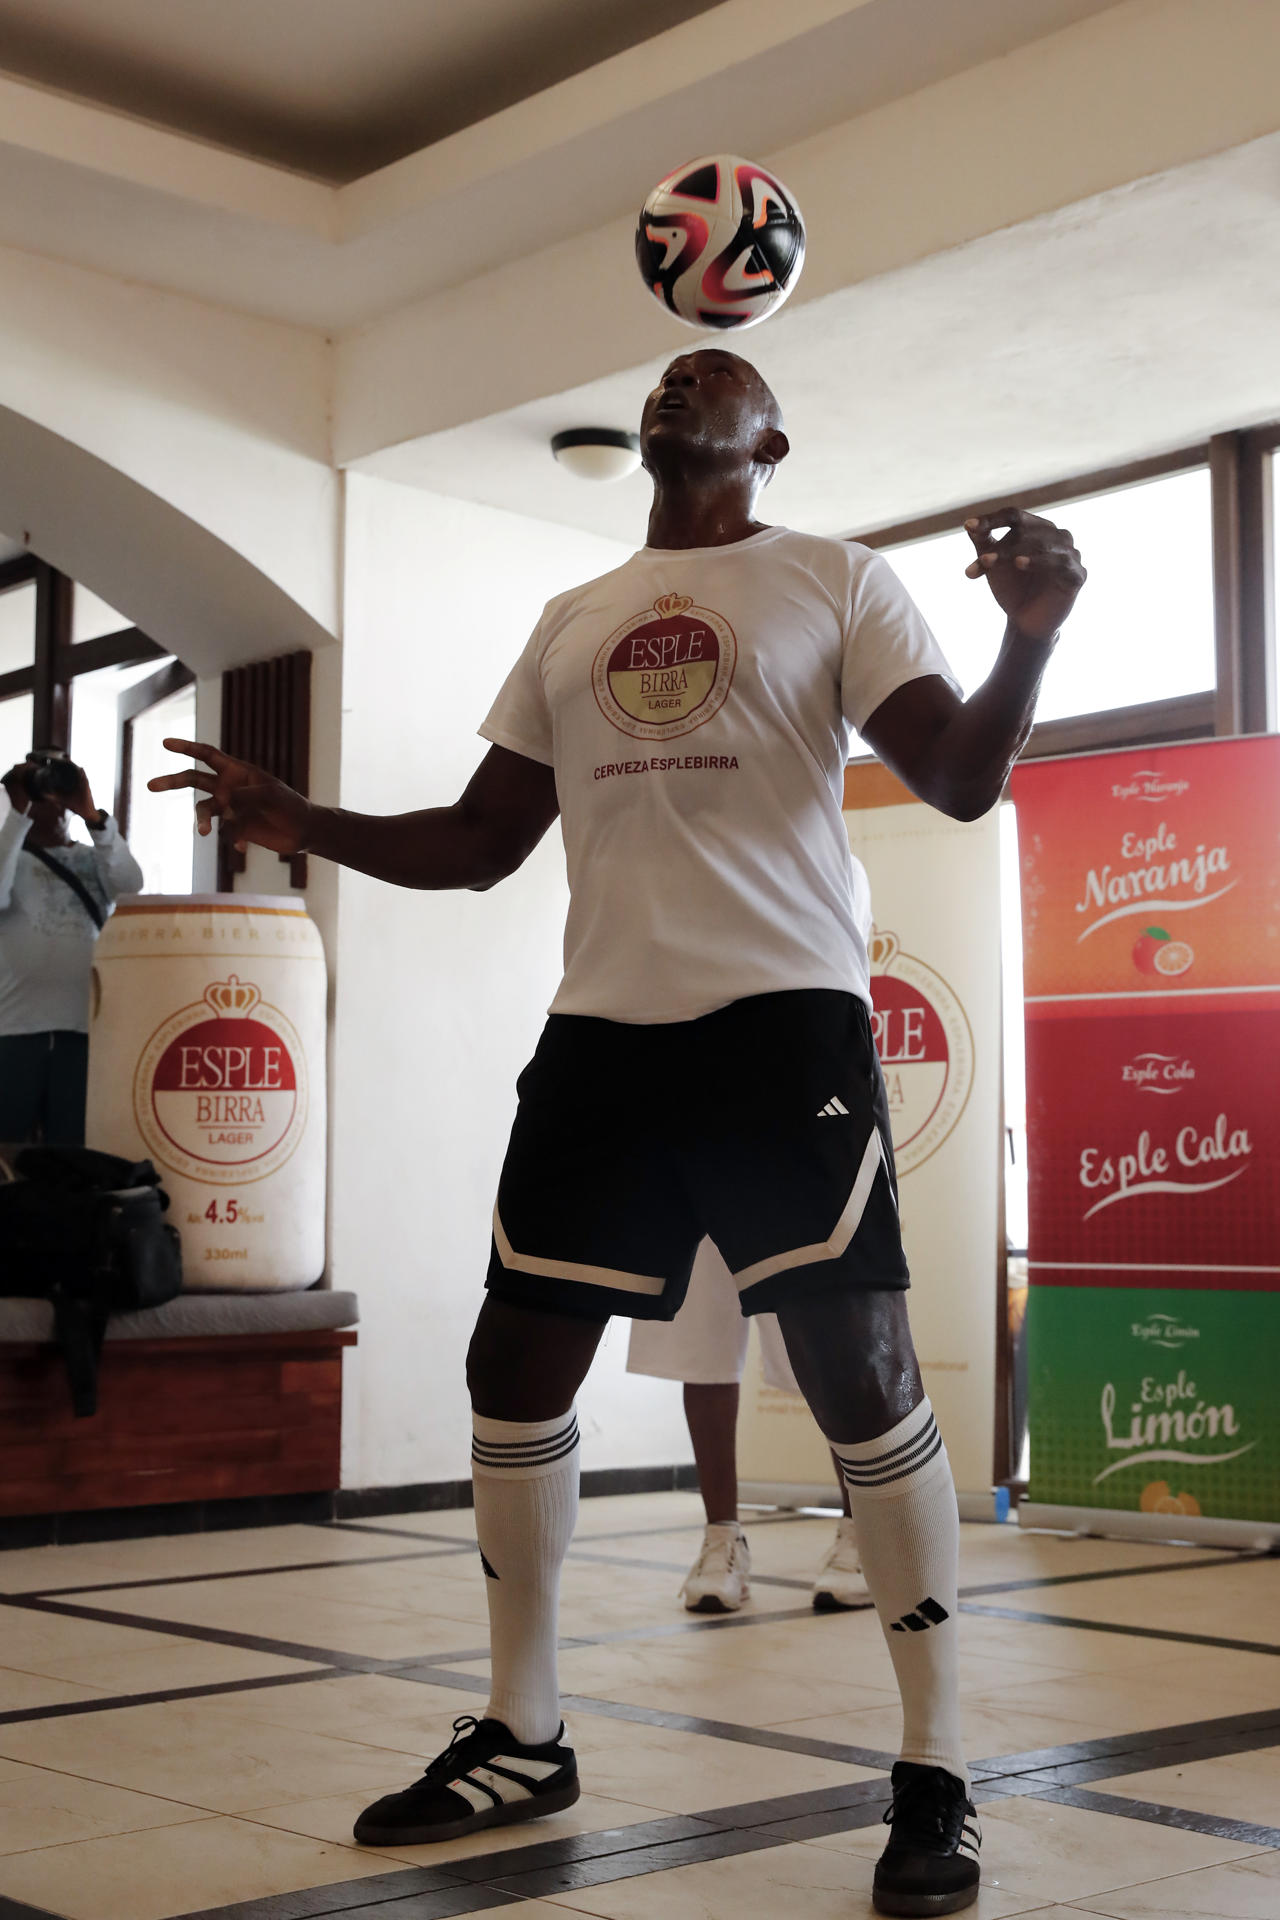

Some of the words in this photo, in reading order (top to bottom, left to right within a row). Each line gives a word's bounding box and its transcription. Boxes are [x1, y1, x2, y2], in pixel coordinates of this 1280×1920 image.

[627, 630, 706, 669] ESPLE
[640, 668, 688, 694] BIRRA
[648, 698, 681, 710] LAGER
[1120, 822, 1177, 862] Esple
[1075, 845, 1231, 912] Naranja
[178, 1045, 282, 1089] ESPLE
[1121, 1062, 1159, 1085] Esple
[1162, 1060, 1196, 1081] Cola
[195, 1095, 266, 1123] BIRRA
[208, 1132, 254, 1145] LAGER
[1079, 1130, 1169, 1192] Esple
[1176, 1113, 1253, 1167] Cola
[204, 1248, 249, 1261] 330ml
[1141, 1370, 1197, 1407] Esple
[1101, 1382, 1240, 1449] Limón
